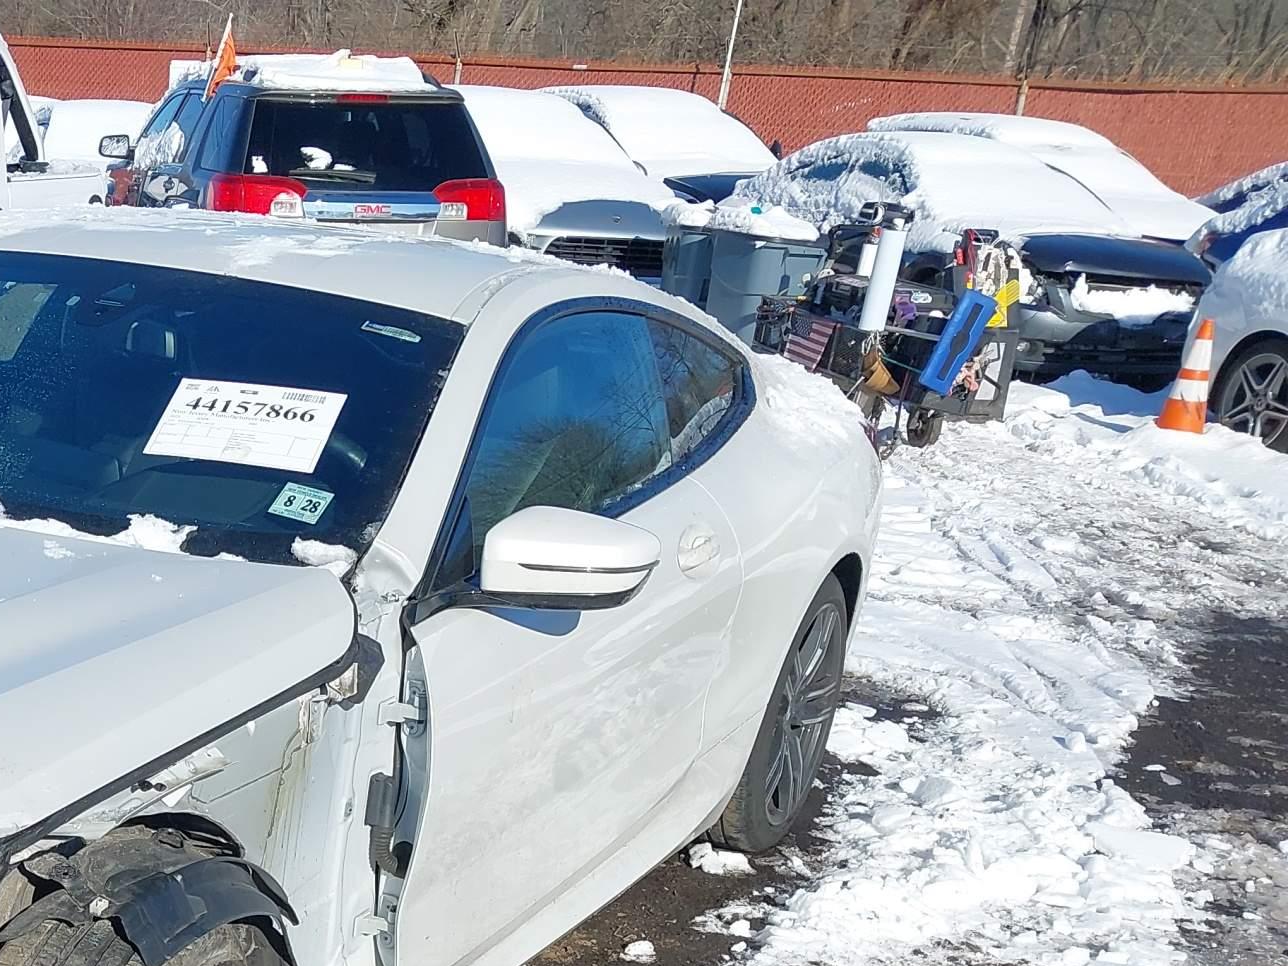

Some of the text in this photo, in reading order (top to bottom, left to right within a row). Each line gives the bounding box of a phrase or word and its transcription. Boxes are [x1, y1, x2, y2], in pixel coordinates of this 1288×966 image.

[354, 204, 392, 214] GMC
[185, 396, 320, 423] 44157866
[283, 495, 297, 508] 8
[300, 499, 322, 514] 28
